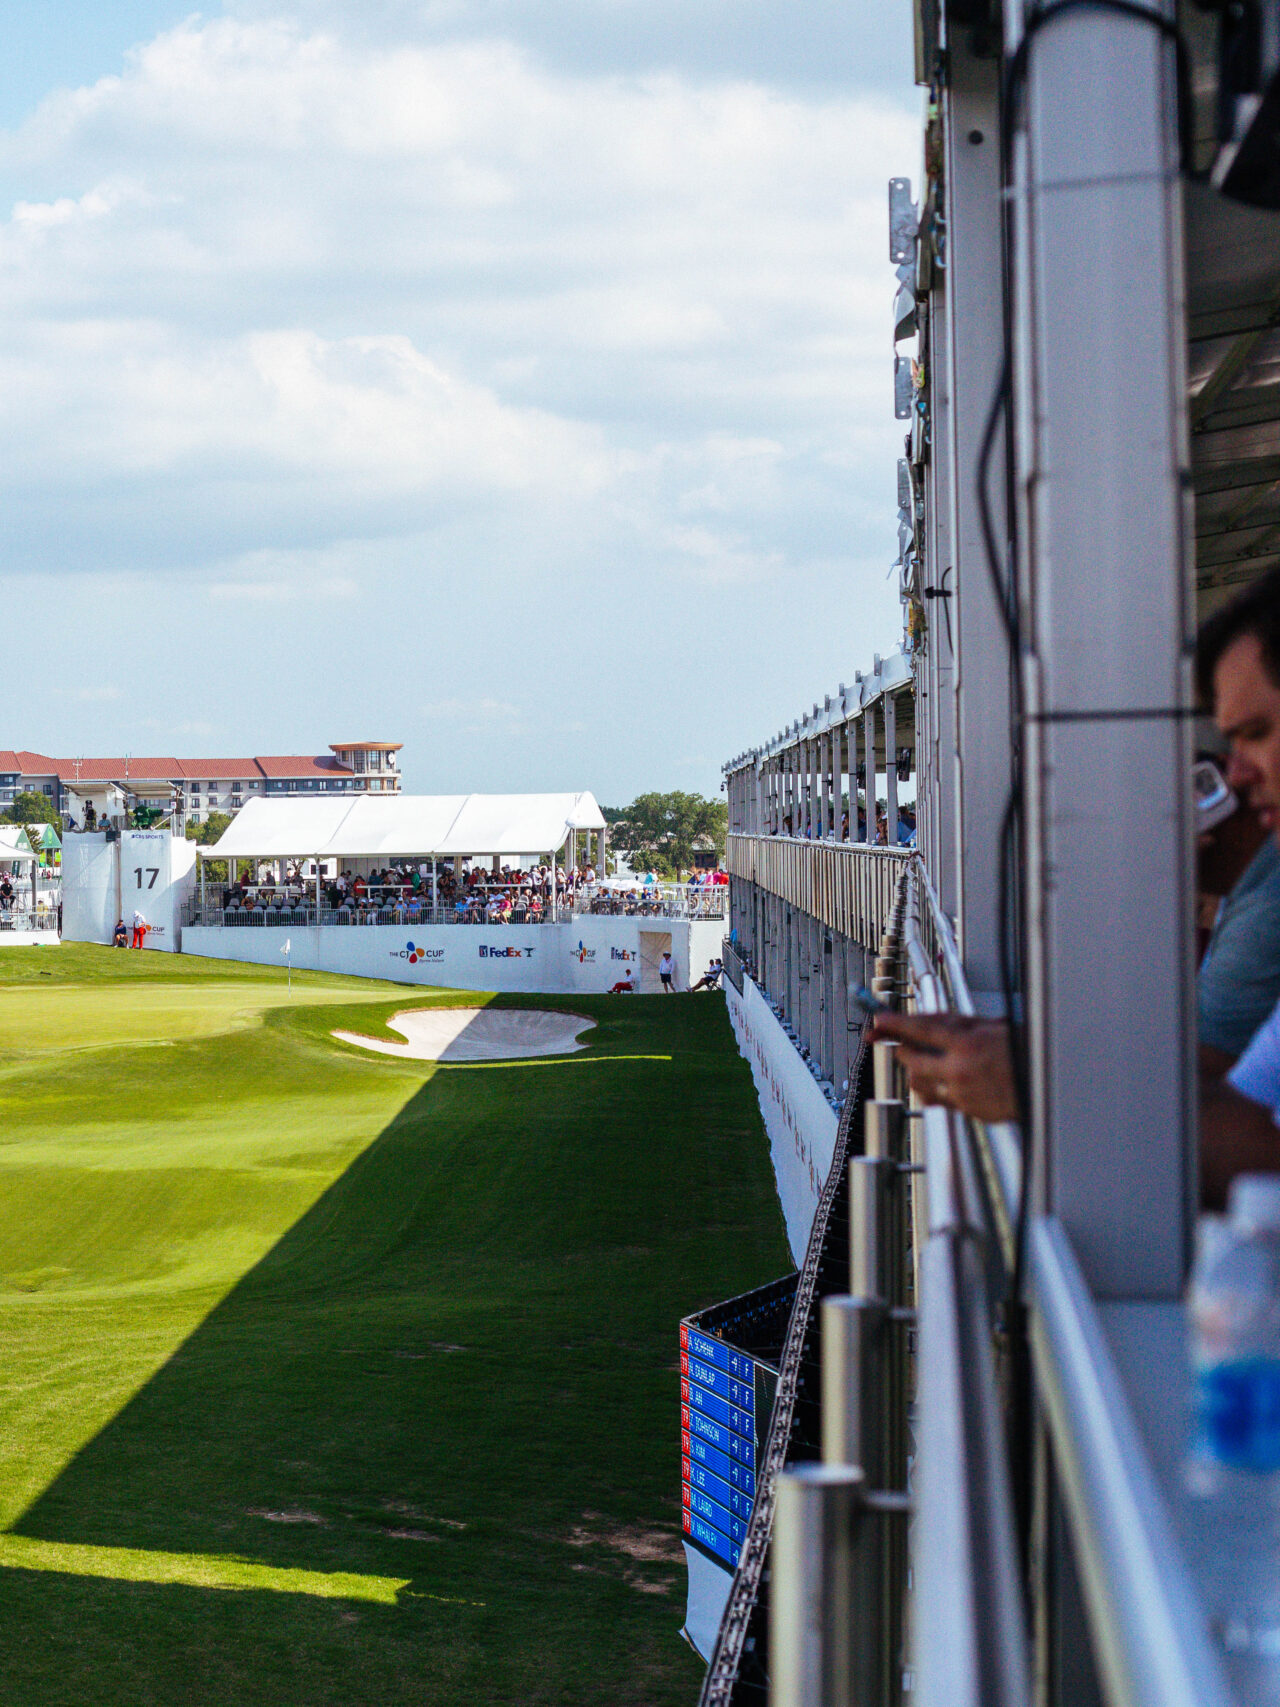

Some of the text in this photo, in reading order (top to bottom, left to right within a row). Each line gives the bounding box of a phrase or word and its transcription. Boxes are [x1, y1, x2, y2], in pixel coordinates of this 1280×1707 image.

[134, 867, 160, 889] 17
[400, 950, 409, 960] CJ
[426, 950, 444, 958] CUP
[490, 946, 522, 958] FedEx
[696, 1416, 720, 1441] JOHNSON
[696, 1469, 706, 1487] LEE
[697, 1496, 713, 1517] LAIRD
